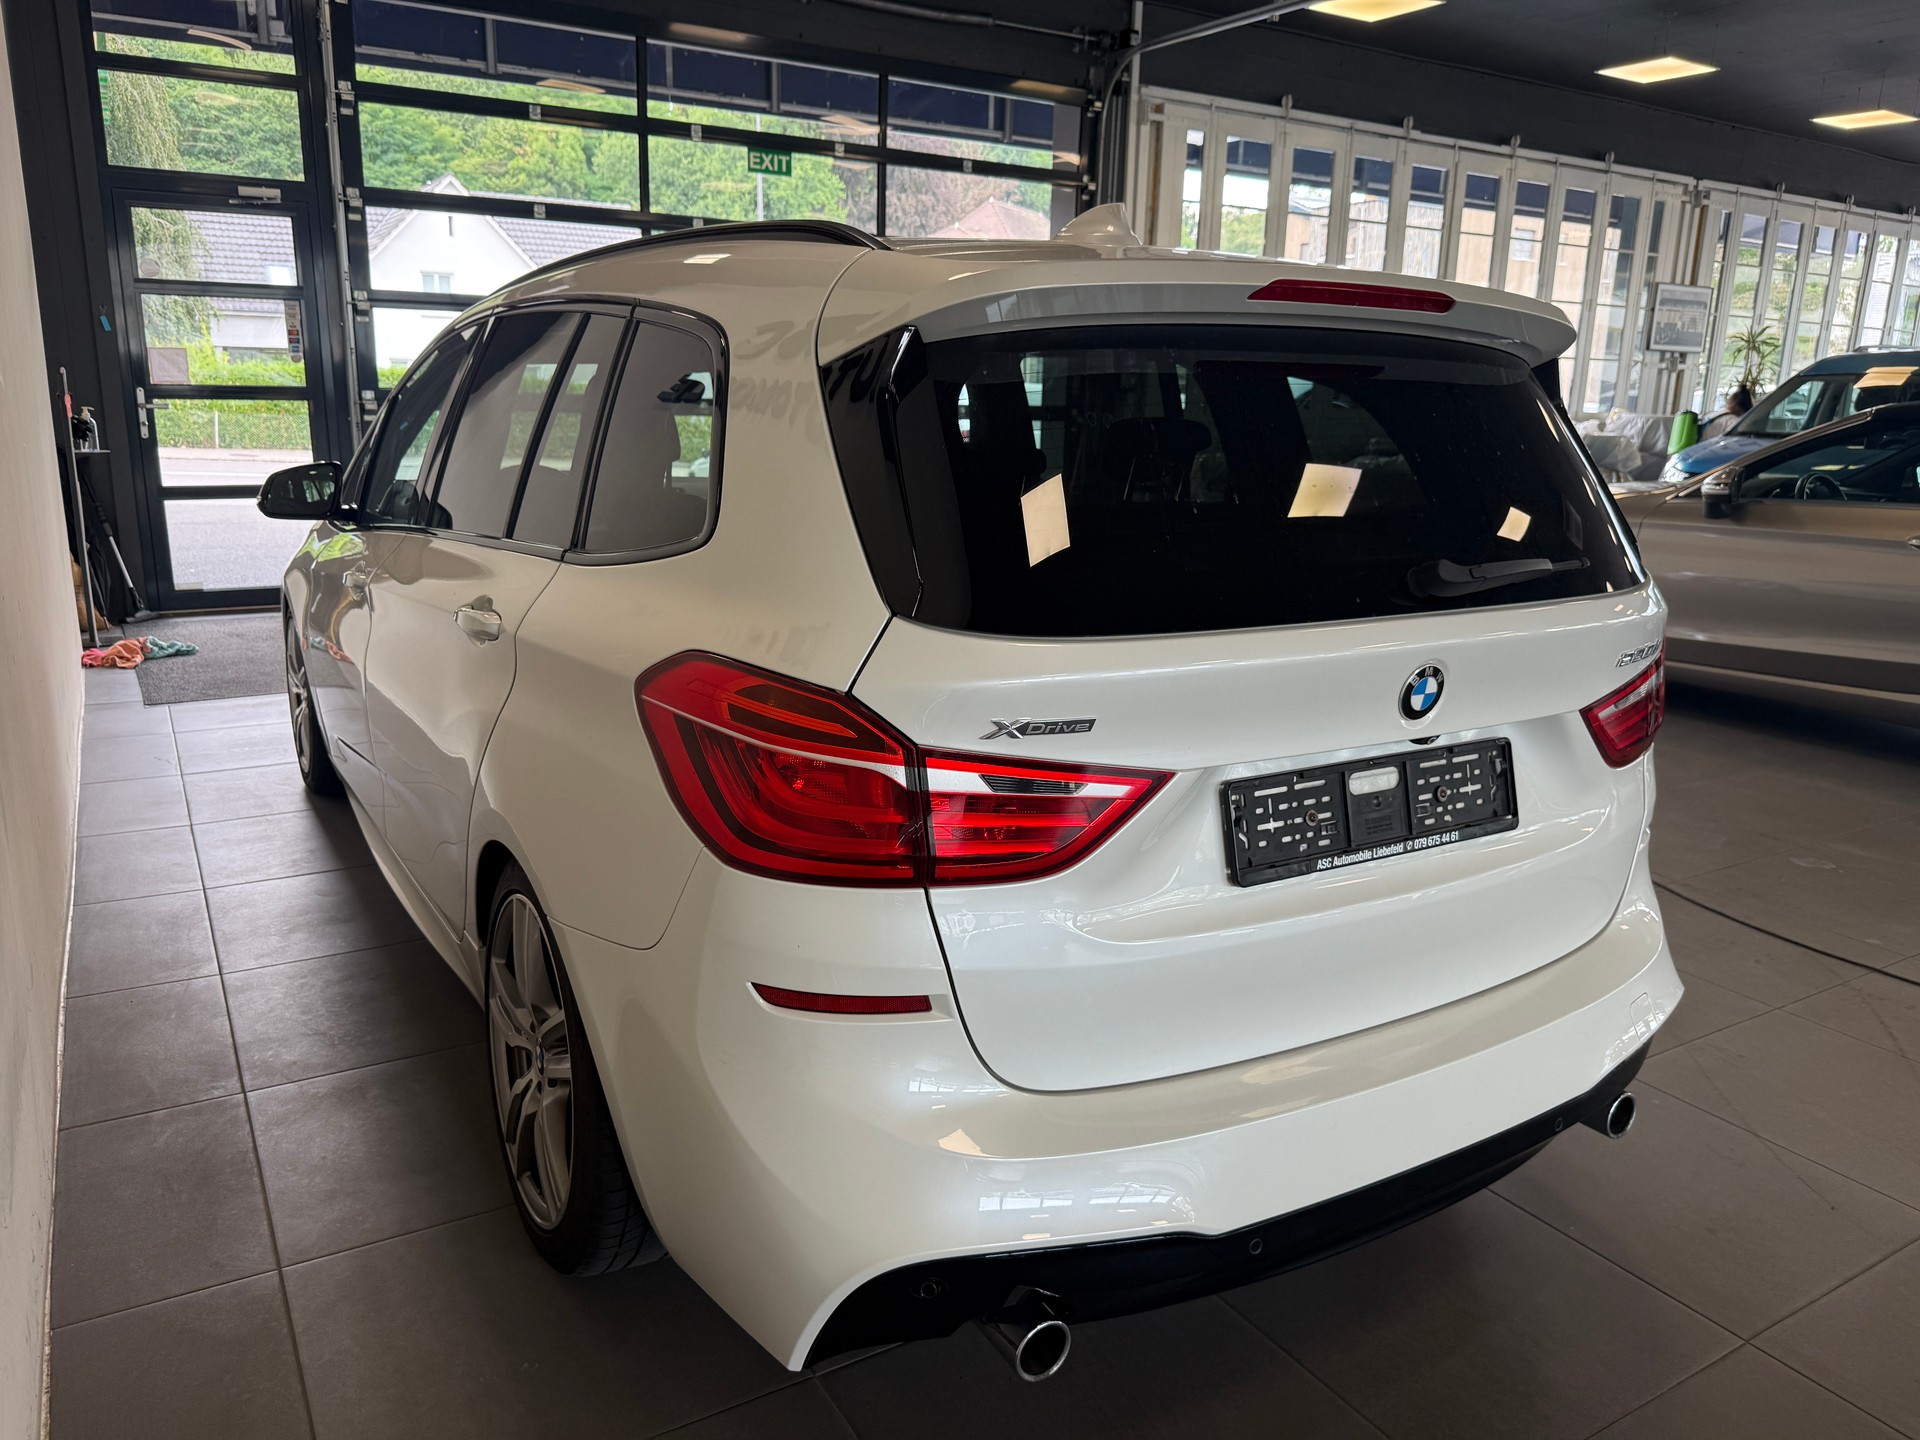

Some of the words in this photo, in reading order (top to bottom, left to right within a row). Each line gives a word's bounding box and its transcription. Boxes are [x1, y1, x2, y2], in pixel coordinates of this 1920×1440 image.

[750, 152, 790, 172] EXIT
[1410, 666, 1444, 686] BMW
[1317, 858, 1332, 870] ASC
[1333, 849, 1372, 866] Automobile
[1373, 842, 1404, 858] Liebefeld
[1414, 838, 1427, 849] 079
[1428, 834, 1441, 846] 675
[1442, 832, 1450, 843] 44
[1451, 830, 1459, 841] 61
